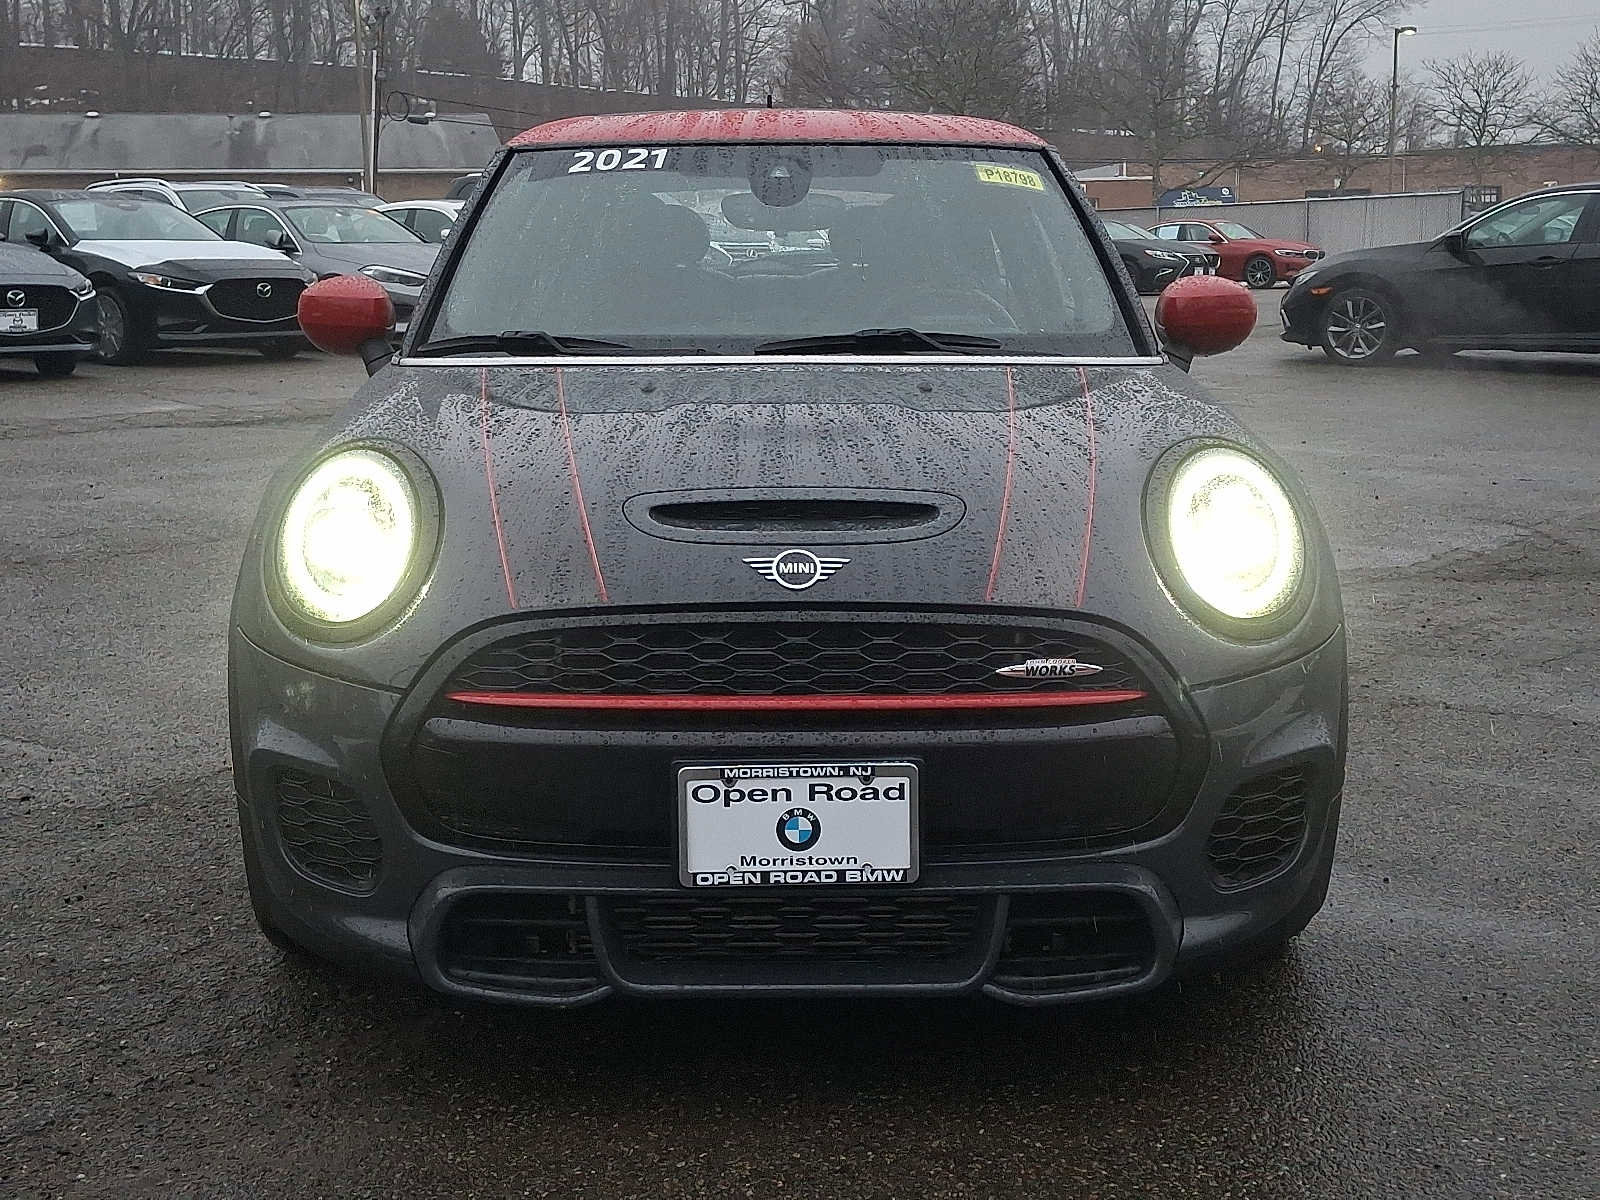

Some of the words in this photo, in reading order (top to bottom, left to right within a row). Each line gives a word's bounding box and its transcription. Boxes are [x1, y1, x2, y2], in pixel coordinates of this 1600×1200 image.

[567, 148, 668, 174] 2021
[984, 168, 1037, 187] P18798
[780, 562, 815, 574] MINI
[1025, 665, 1076, 676] WORKS
[850, 766, 872, 776] NJ
[691, 784, 792, 807] Open
[808, 783, 906, 801] Road
[782, 809, 816, 821] BMW
[740, 855, 858, 867] Morristown
[696, 871, 761, 885] OPEN
[769, 870, 838, 884] ROAD
[845, 869, 904, 883] BMW
